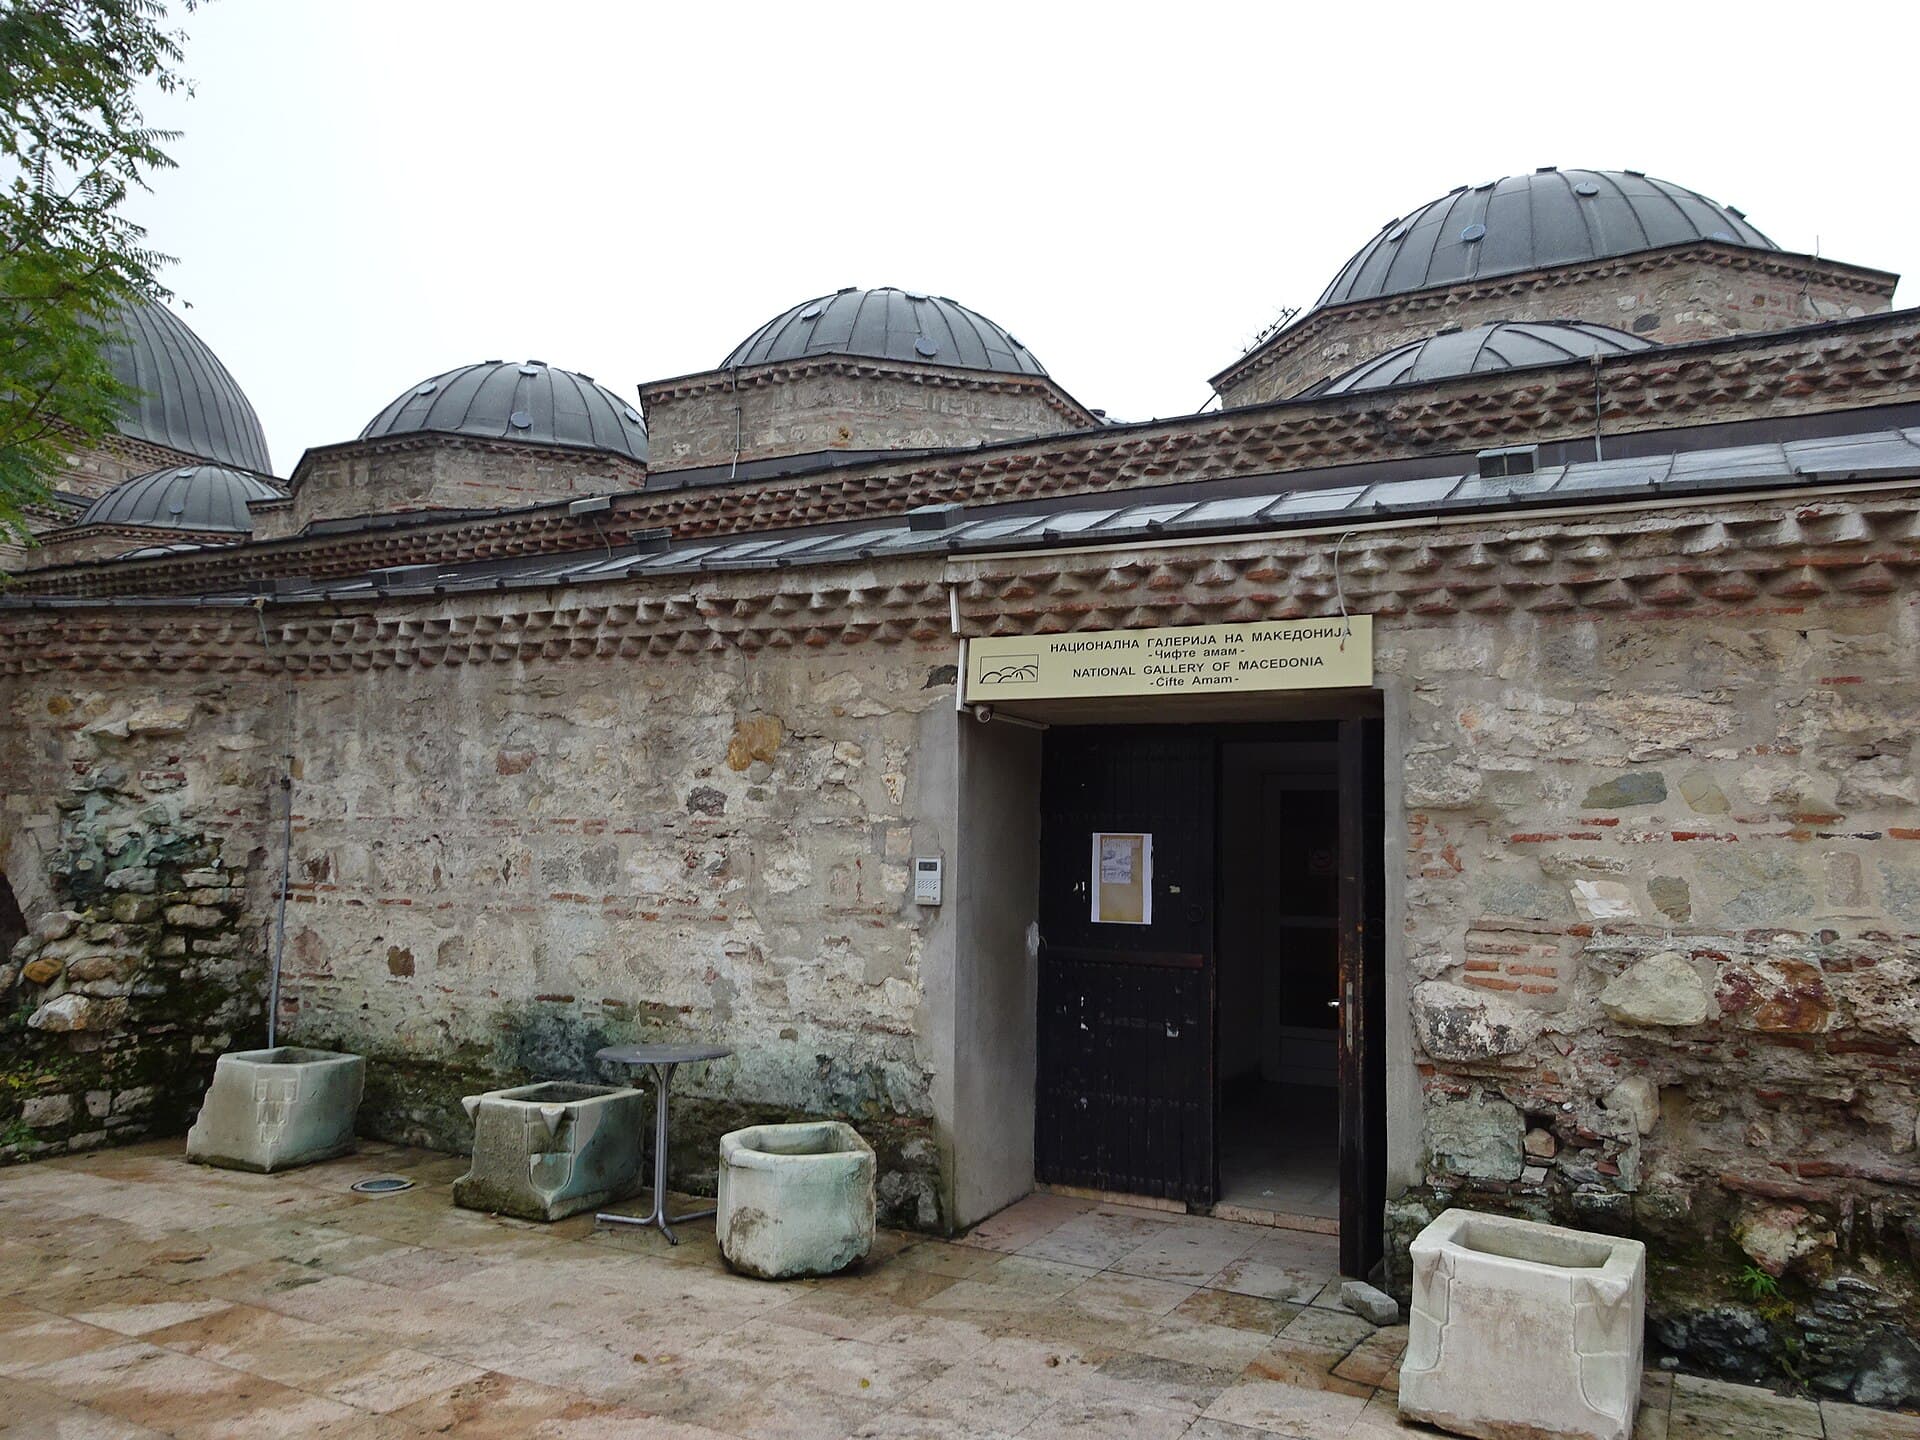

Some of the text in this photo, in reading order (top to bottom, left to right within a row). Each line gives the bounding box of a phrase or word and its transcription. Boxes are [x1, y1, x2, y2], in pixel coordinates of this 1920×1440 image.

[1050, 627, 1352, 653] НАЦИОНАЛНА ГАЛЕРИЈА НА МАКЕДОНИЈА
[1072, 656, 1324, 678] NATIONAL GALLERY OF MACEDONIA
